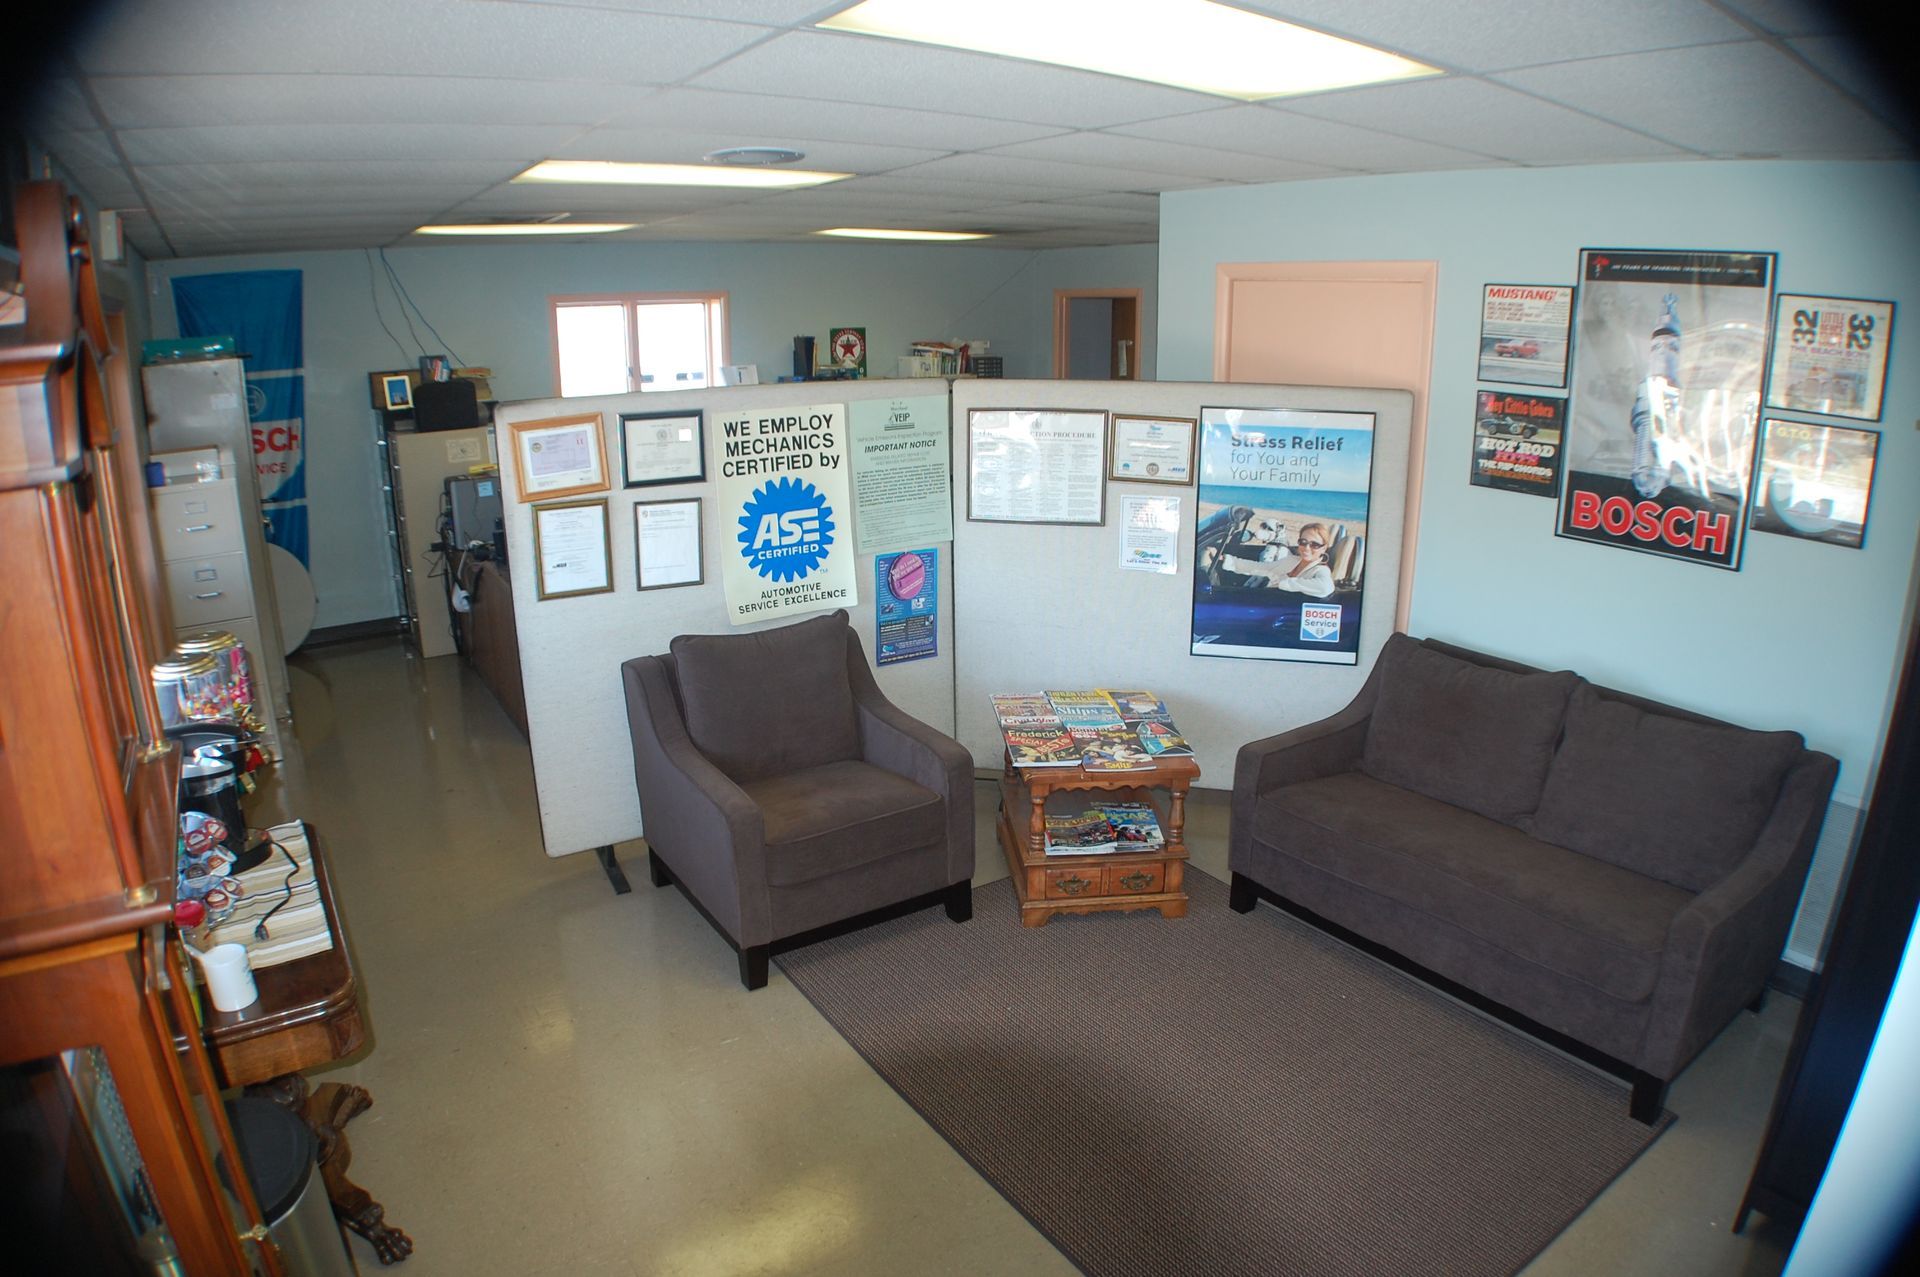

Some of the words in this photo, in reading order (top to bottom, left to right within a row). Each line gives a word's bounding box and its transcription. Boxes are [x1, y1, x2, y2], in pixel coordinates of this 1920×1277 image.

[1792, 310, 1819, 345] 32
[1846, 314, 1875, 350] 32
[723, 420, 751, 438] WE
[758, 413, 833, 435] EMPLOY
[894, 412, 911, 423] VEIP
[251, 426, 299, 454] SCH
[725, 432, 835, 458] MECHANICS
[864, 442, 907, 454] IMPORTANT
[909, 439, 937, 449] NOTICE
[1231, 433, 1286, 449] Stress
[1291, 436, 1344, 451] Relief
[1479, 437, 1519, 453] HOT
[1516, 442, 1556, 458] ROD
[722, 453, 813, 478] CERTIFIED
[819, 452, 840, 470] by
[1231, 449, 1253, 465] for
[1256, 451, 1285, 466] You
[1290, 453, 1319, 467] and
[1230, 466, 1265, 481] Your
[1269, 468, 1320, 487] Family
[752, 508, 820, 549] ASE
[1570, 489, 1731, 555] BOSCH
[758, 543, 819, 560] CERTIFIED
[761, 582, 821, 599] AUTOMOTIVE
[738, 600, 779, 614] SERVICE
[784, 589, 847, 606] EXCELLENCE
[1304, 619, 1337, 627] Service
[1305, 610, 1337, 619] BOSCH
[1008, 729, 1065, 738] Frederick
